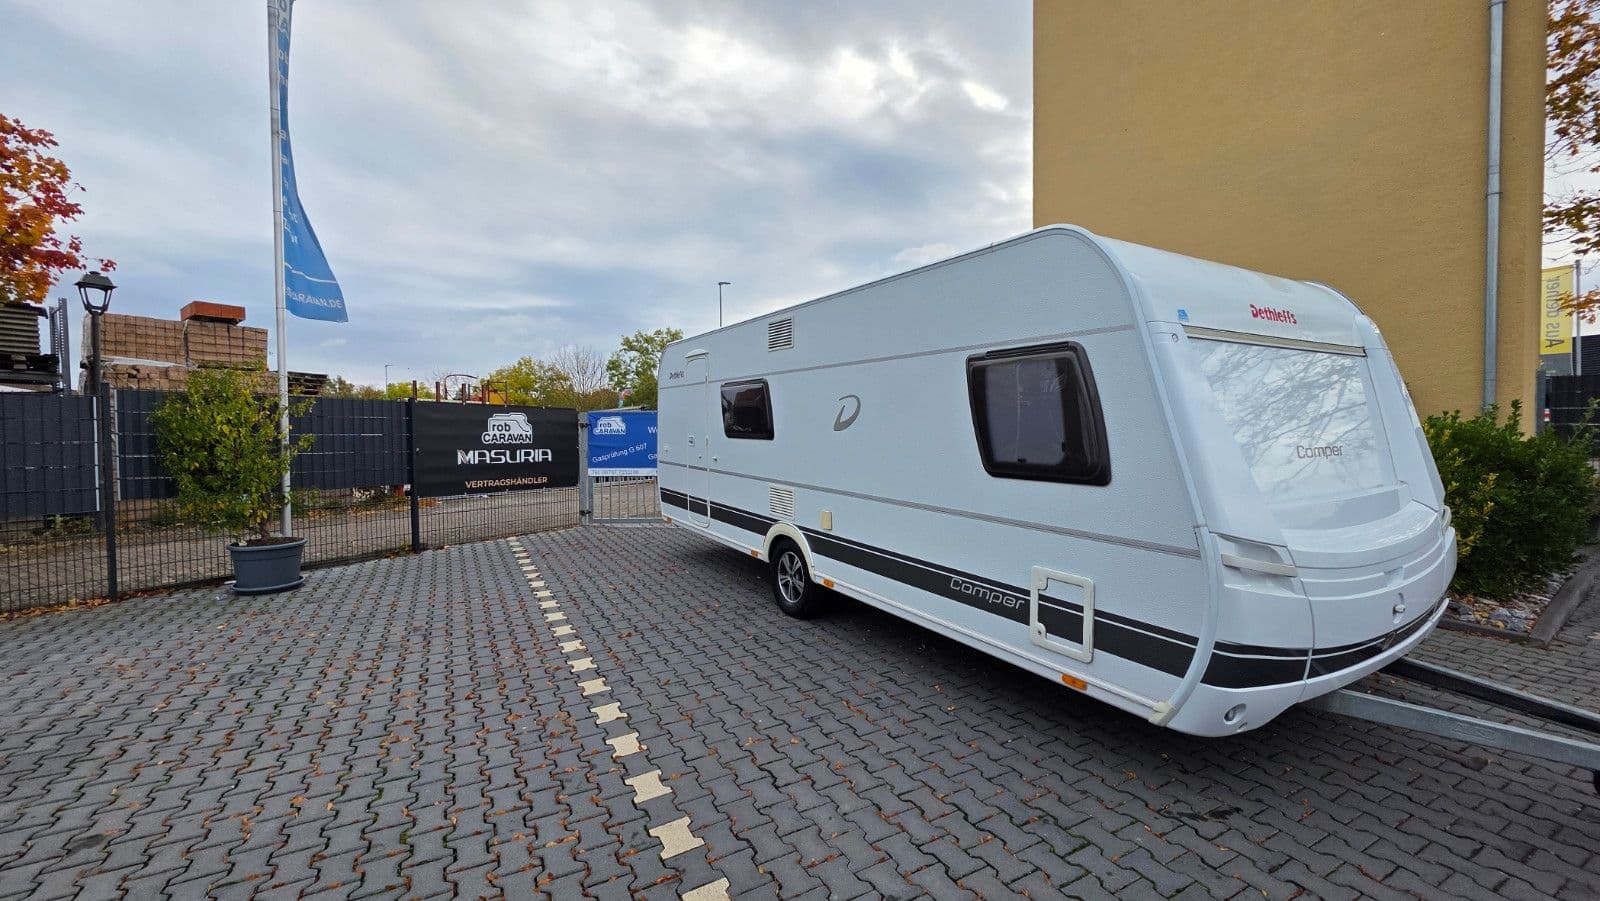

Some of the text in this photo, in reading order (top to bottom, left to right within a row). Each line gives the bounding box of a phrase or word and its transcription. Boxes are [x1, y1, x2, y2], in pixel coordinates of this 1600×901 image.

[1249, 304, 1297, 325] Dethleffs
[492, 422, 511, 432] rob
[483, 433, 532, 443] CARAVAN
[456, 448, 552, 465] MASURIA
[1296, 445, 1343, 460] Camper
[465, 476, 549, 489] VERTRAGSHÄNDLER
[950, 577, 1025, 609] Camper
